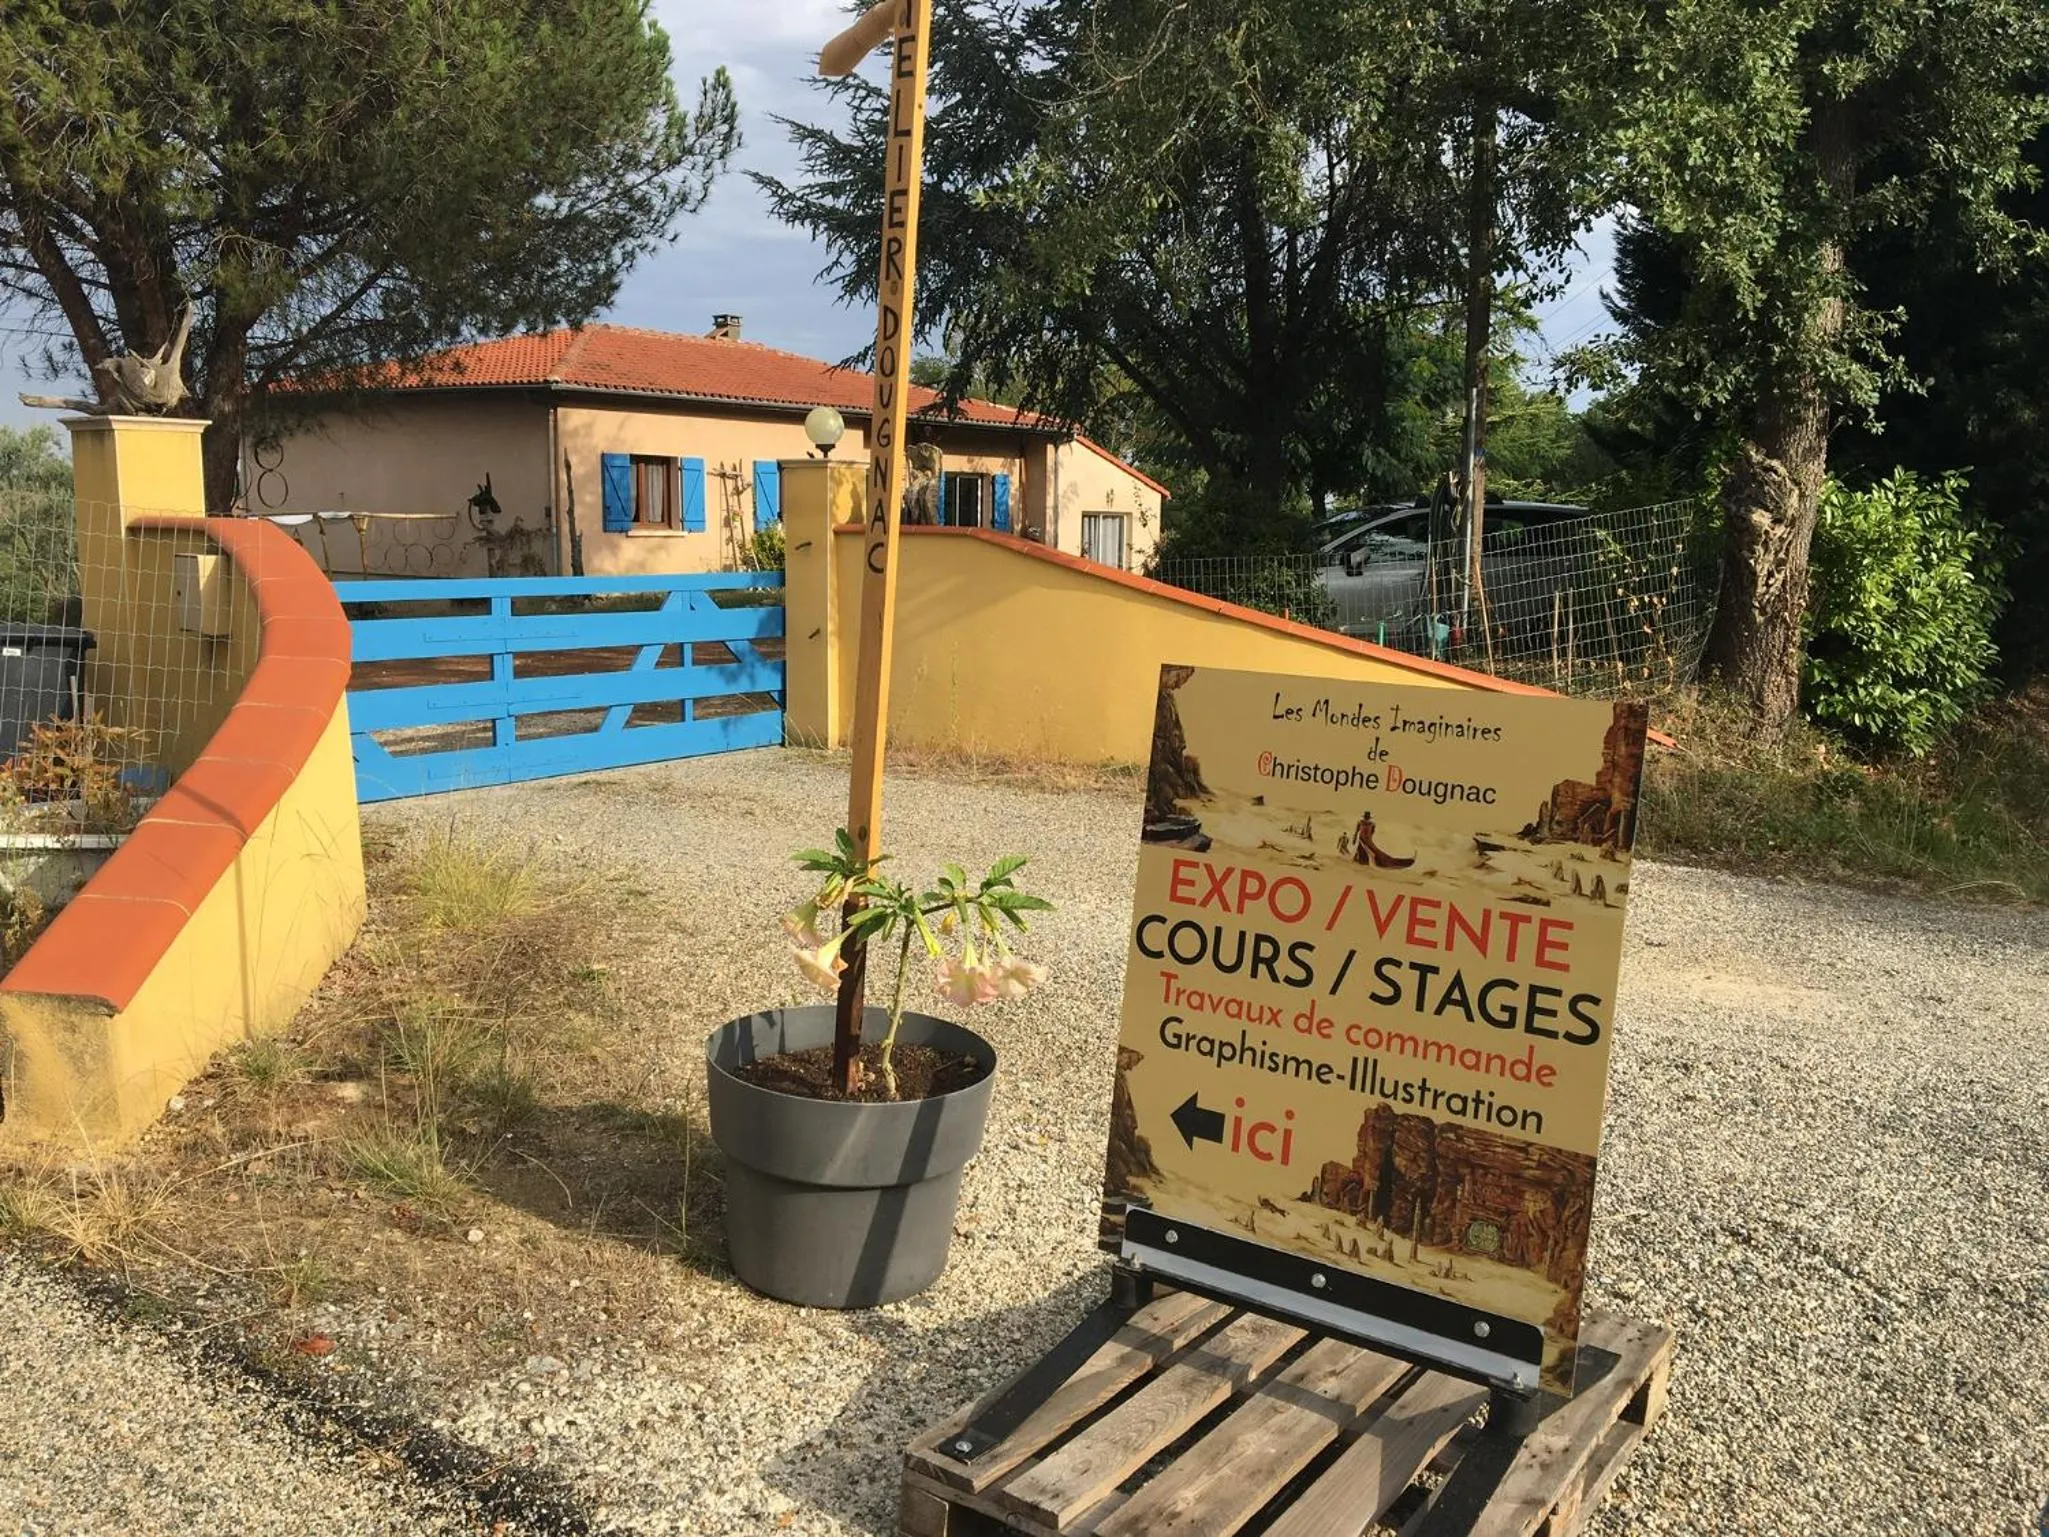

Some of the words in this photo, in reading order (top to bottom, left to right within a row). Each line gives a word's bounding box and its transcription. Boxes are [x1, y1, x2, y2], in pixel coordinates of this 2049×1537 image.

[867, 304, 899, 574] DOUGNAC
[1272, 693, 1303, 724] Les
[1312, 699, 1380, 731] Mondes
[1390, 706, 1502, 744] Imaginaires
[1367, 737, 1389, 763] de
[1257, 750, 1379, 792] Christophe
[1386, 765, 1497, 805] Dougnac
[1169, 858, 1313, 924] EXPO
[1325, 884, 1353, 930] /
[1366, 889, 1575, 972] VENTE
[1135, 913, 1316, 989] COURS
[1329, 948, 1357, 995] /
[1369, 956, 1602, 1045] STAGES
[1160, 971, 1283, 1027] Travaux
[1293, 1003, 1335, 1039] de
[1345, 1022, 1558, 1088] commande
[1159, 1016, 1544, 1134] Graphisme-Illustration
[1230, 1097, 1297, 1167] ici
